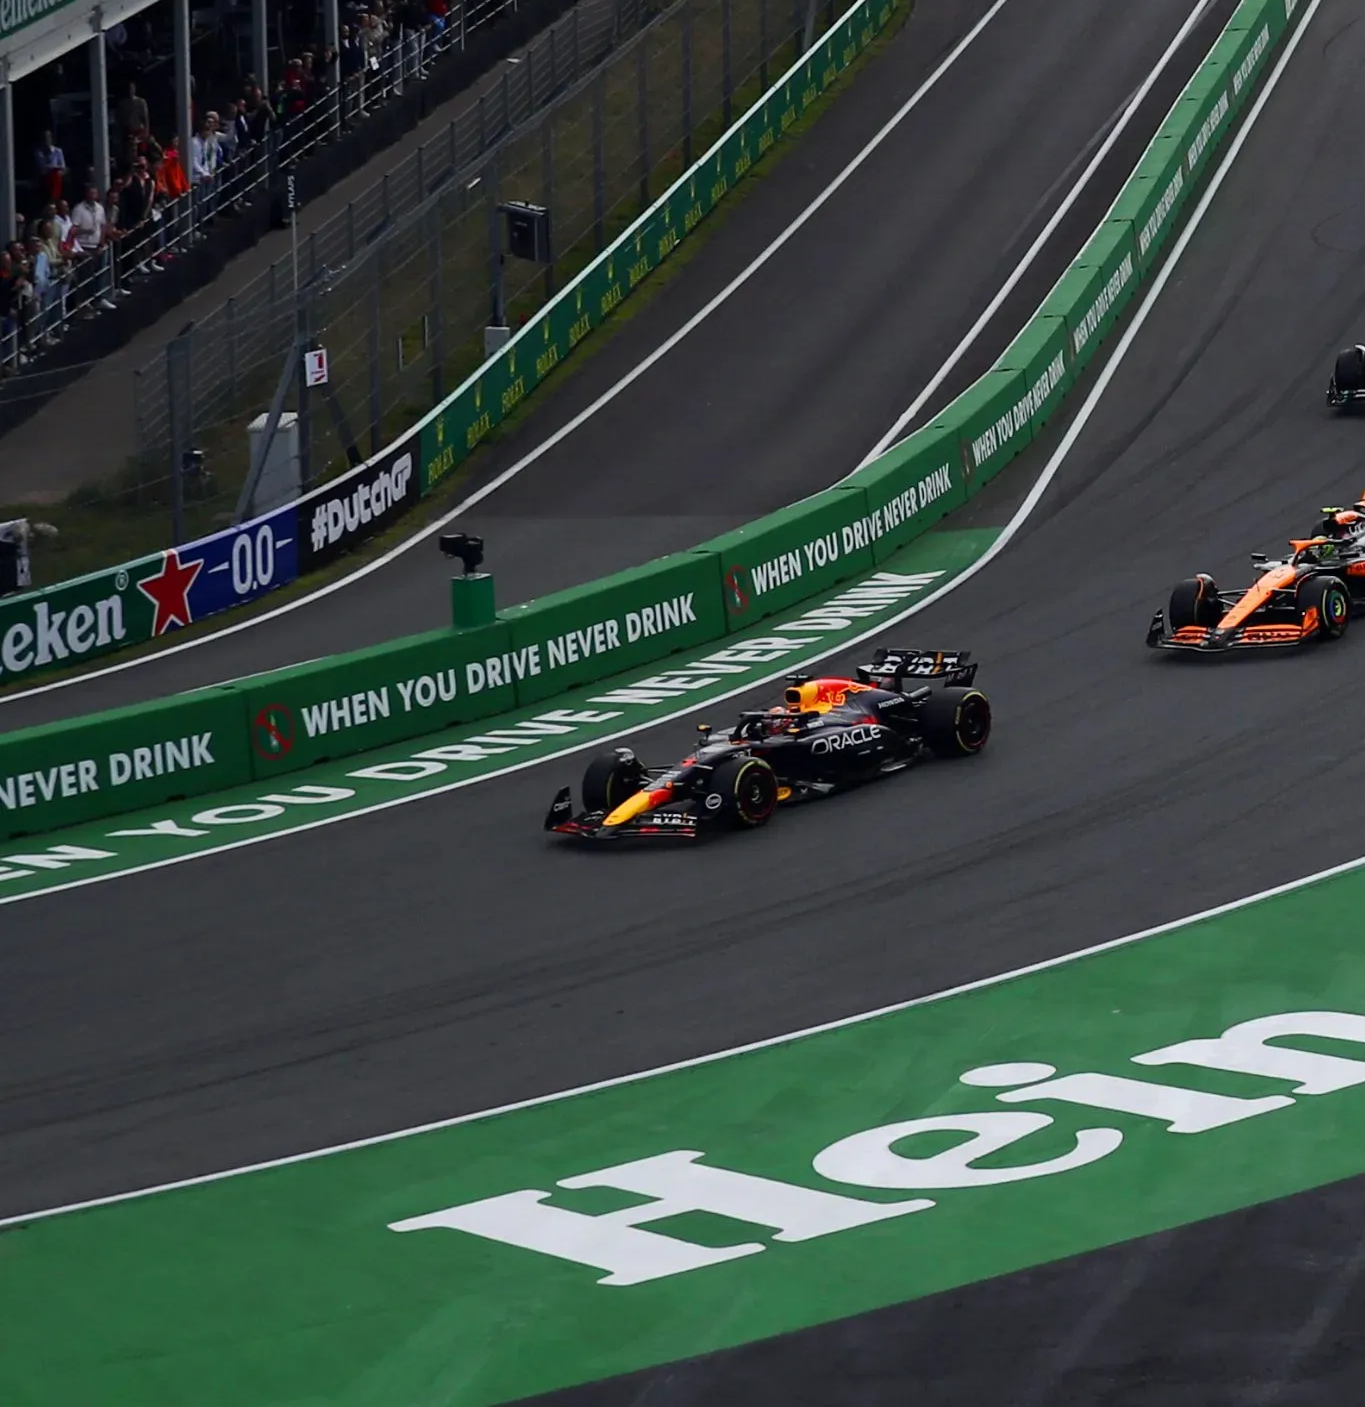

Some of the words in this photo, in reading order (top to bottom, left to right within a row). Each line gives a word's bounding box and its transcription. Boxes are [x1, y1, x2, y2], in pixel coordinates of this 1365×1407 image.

[428, 444, 454, 484] ROLEX
[972, 426, 997, 467] WHEN
[996, 410, 1014, 446] YOU
[1013, 390, 1034, 431] DRIVE
[1032, 371, 1050, 411] NEVER
[751, 549, 802, 595] WHEN
[804, 532, 838, 571] YOU
[842, 509, 883, 555] DRIVE
[884, 487, 918, 532] NEVER
[918, 463, 952, 509] DRINK
[0, 592, 126, 672] eken
[232, 525, 274, 594] 0.0
[105, 785, 356, 837] YOU
[346, 709, 624, 782] DRIVE
[586, 637, 823, 705] NEVER
[774, 570, 947, 632] DRINK
[301, 687, 391, 738] WHEN
[396, 669, 457, 712] YOU
[466, 644, 541, 694] DRIVE
[547, 618, 621, 669] NEVER
[625, 592, 697, 642] DRINK
[0, 759, 99, 811] NEVER
[109, 732, 215, 786] DRINK
[810, 725, 882, 756] ORACLE
